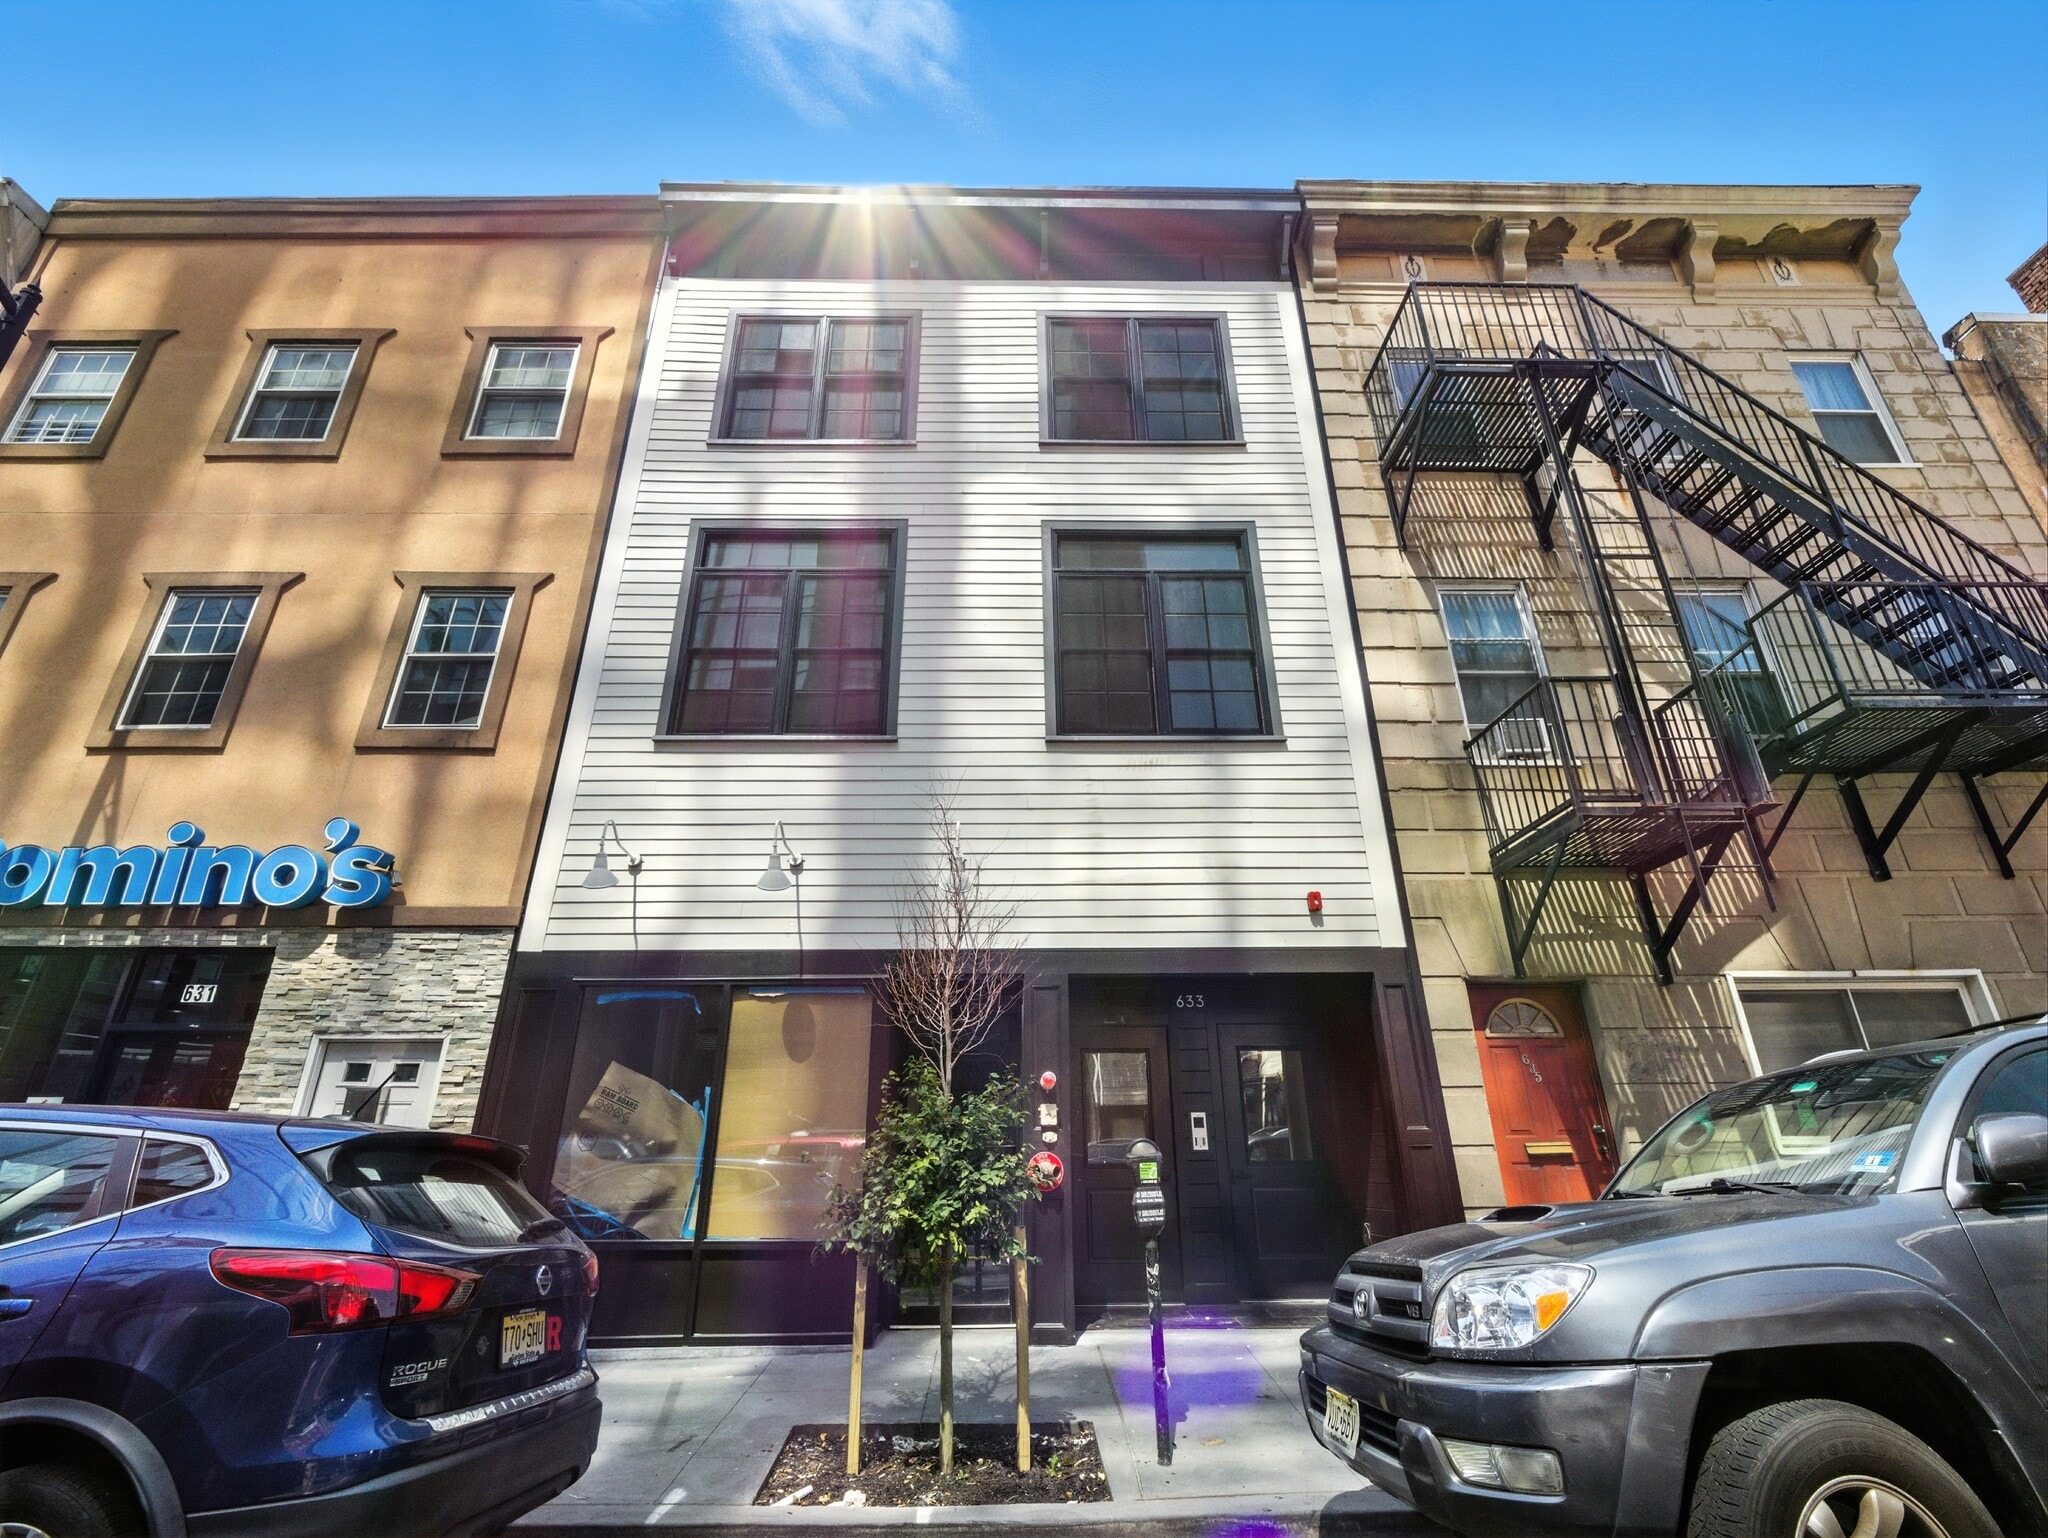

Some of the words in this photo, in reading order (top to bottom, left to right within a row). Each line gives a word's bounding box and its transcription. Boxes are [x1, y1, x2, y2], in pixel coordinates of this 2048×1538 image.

[0, 816, 394, 910] omino's
[183, 985, 215, 1002] 631
[1176, 994, 1205, 1008] 633
[1522, 1053, 1542, 1083] 635
[601, 1088, 617, 1101] RAM
[617, 1096, 639, 1110] BOARD
[547, 1316, 562, 1351] R
[392, 1358, 448, 1377] ROGUE
